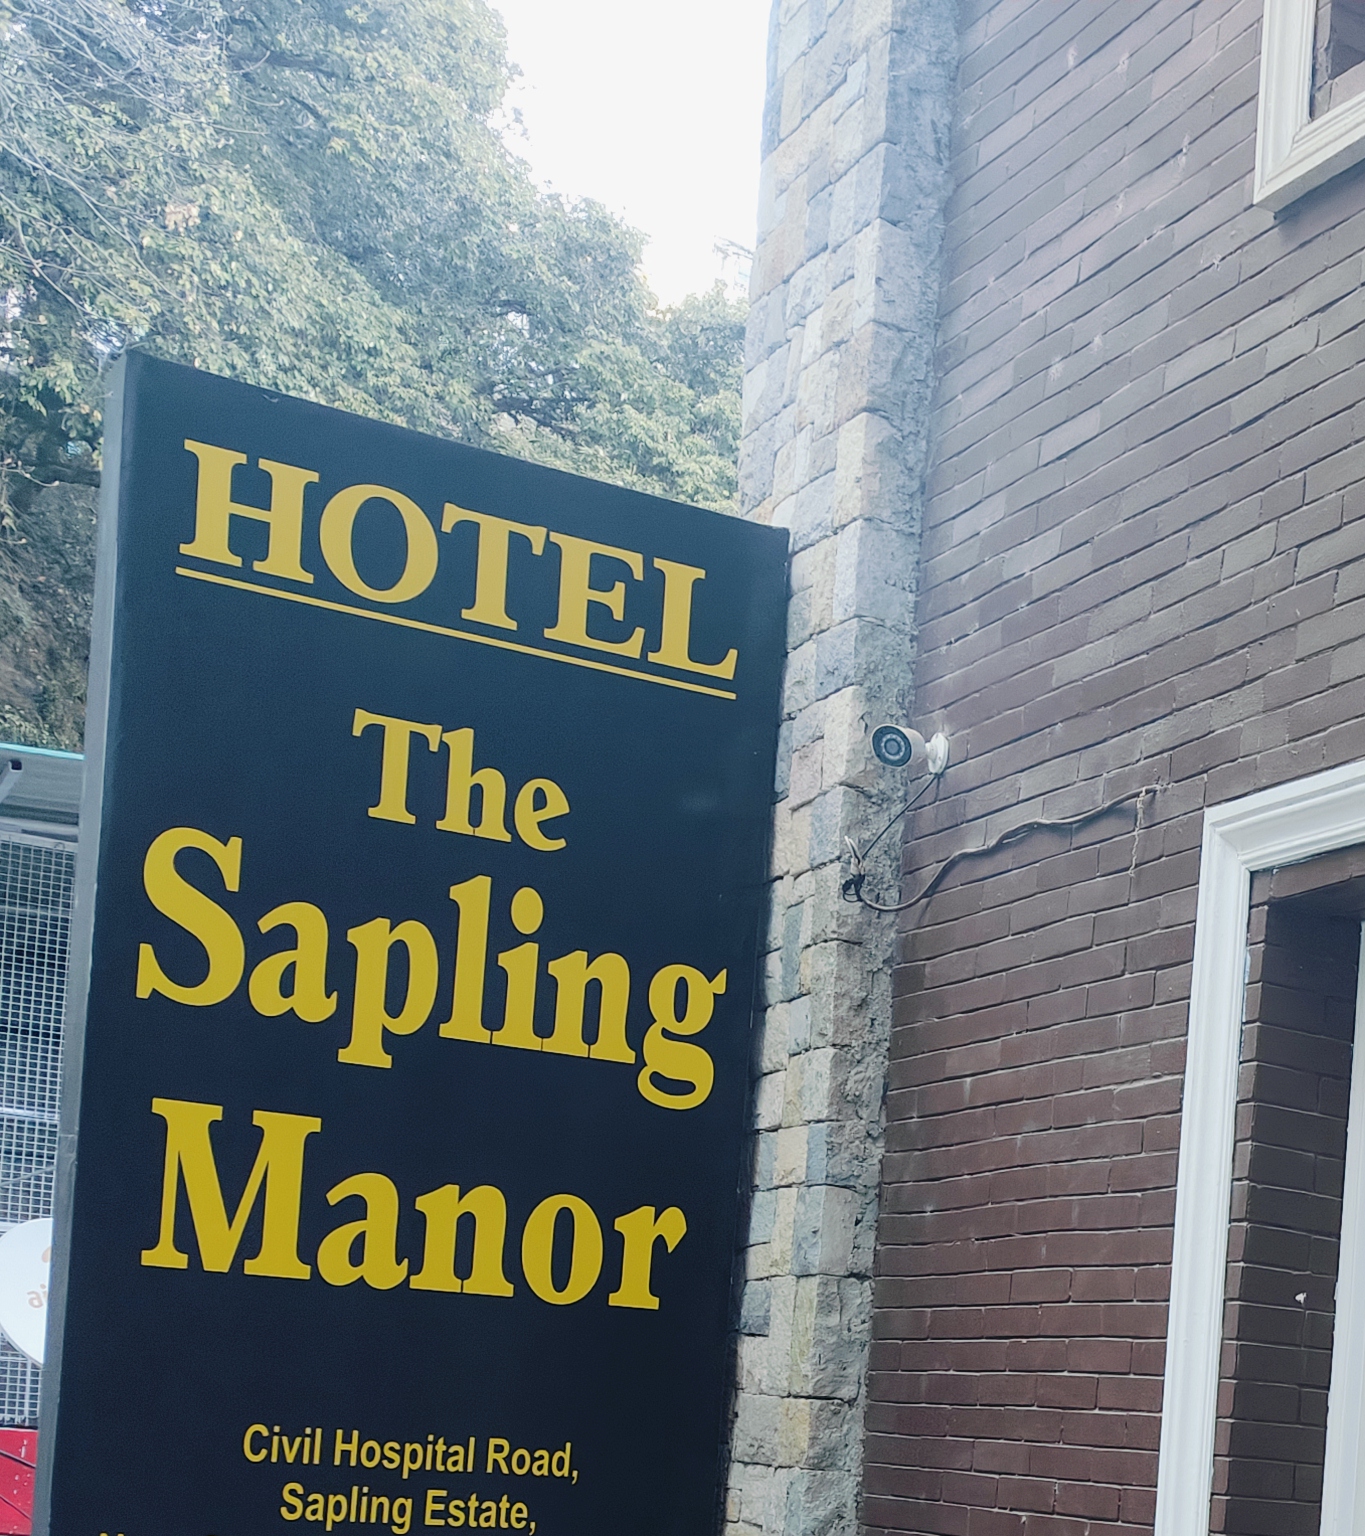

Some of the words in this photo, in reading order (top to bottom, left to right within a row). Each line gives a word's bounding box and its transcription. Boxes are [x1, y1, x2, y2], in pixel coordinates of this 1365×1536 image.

[179, 440, 738, 681] HOTEL
[352, 708, 571, 852] The
[135, 826, 728, 1111] Sapling
[140, 1097, 688, 1310] Manor
[243, 1423, 323, 1465] Civil
[333, 1428, 476, 1480] Hospital
[486, 1437, 579, 1485] Road,
[280, 1482, 413, 1535] Sapling
[424, 1489, 536, 1536] Estate,
